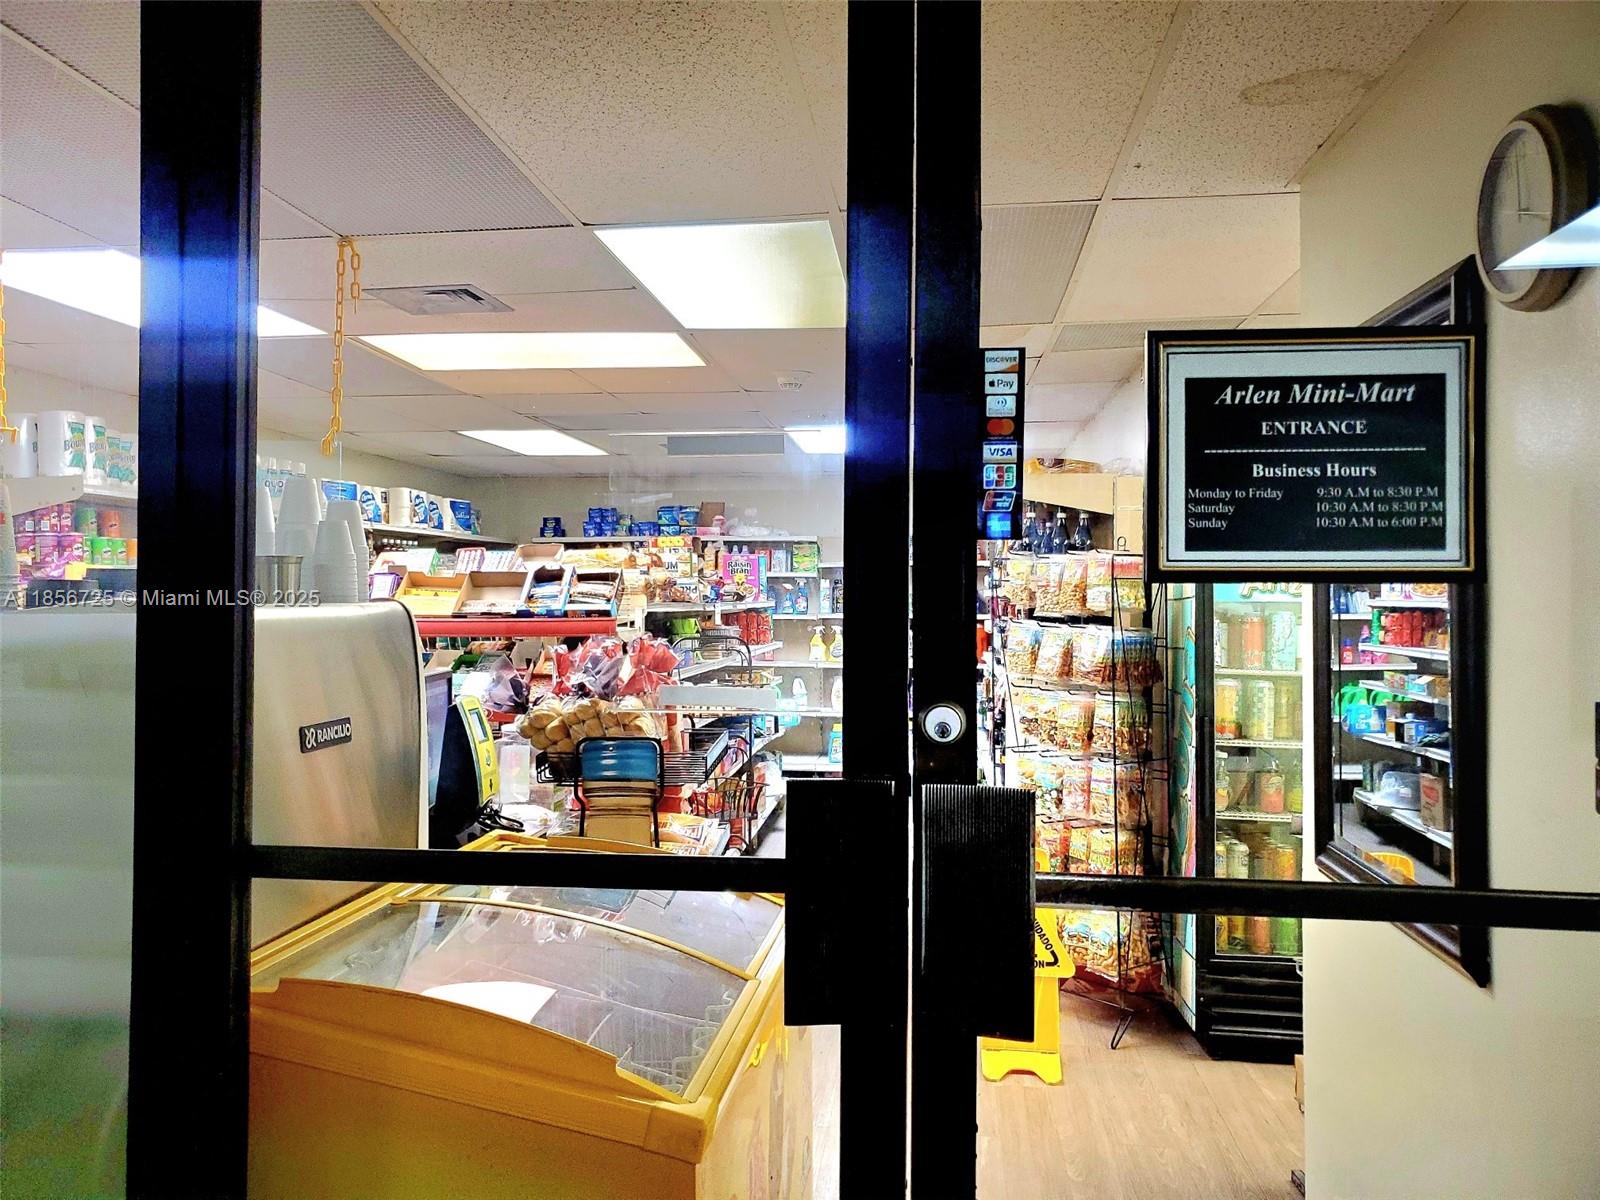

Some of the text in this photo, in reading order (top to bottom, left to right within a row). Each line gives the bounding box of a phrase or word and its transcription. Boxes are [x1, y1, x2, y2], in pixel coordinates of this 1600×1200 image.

[997, 379, 1014, 390] Pay
[1214, 382, 1416, 405] Arlen Mini-Mart
[1261, 420, 1368, 436] ENTRANCE
[989, 447, 1013, 457] VISA
[1252, 462, 1377, 478] Business Hours
[1188, 486, 1439, 501] Monday to Friday 9:30 A.M to 8:30 P.M
[1188, 501, 1443, 515] Saturday 10:30 A.M to 8:30 P.M
[1188, 517, 1443, 530] Sunday 10:30 A.M to 6:00 P.M
[727, 560, 752, 569] Raisin
[730, 567, 750, 575] Bran
